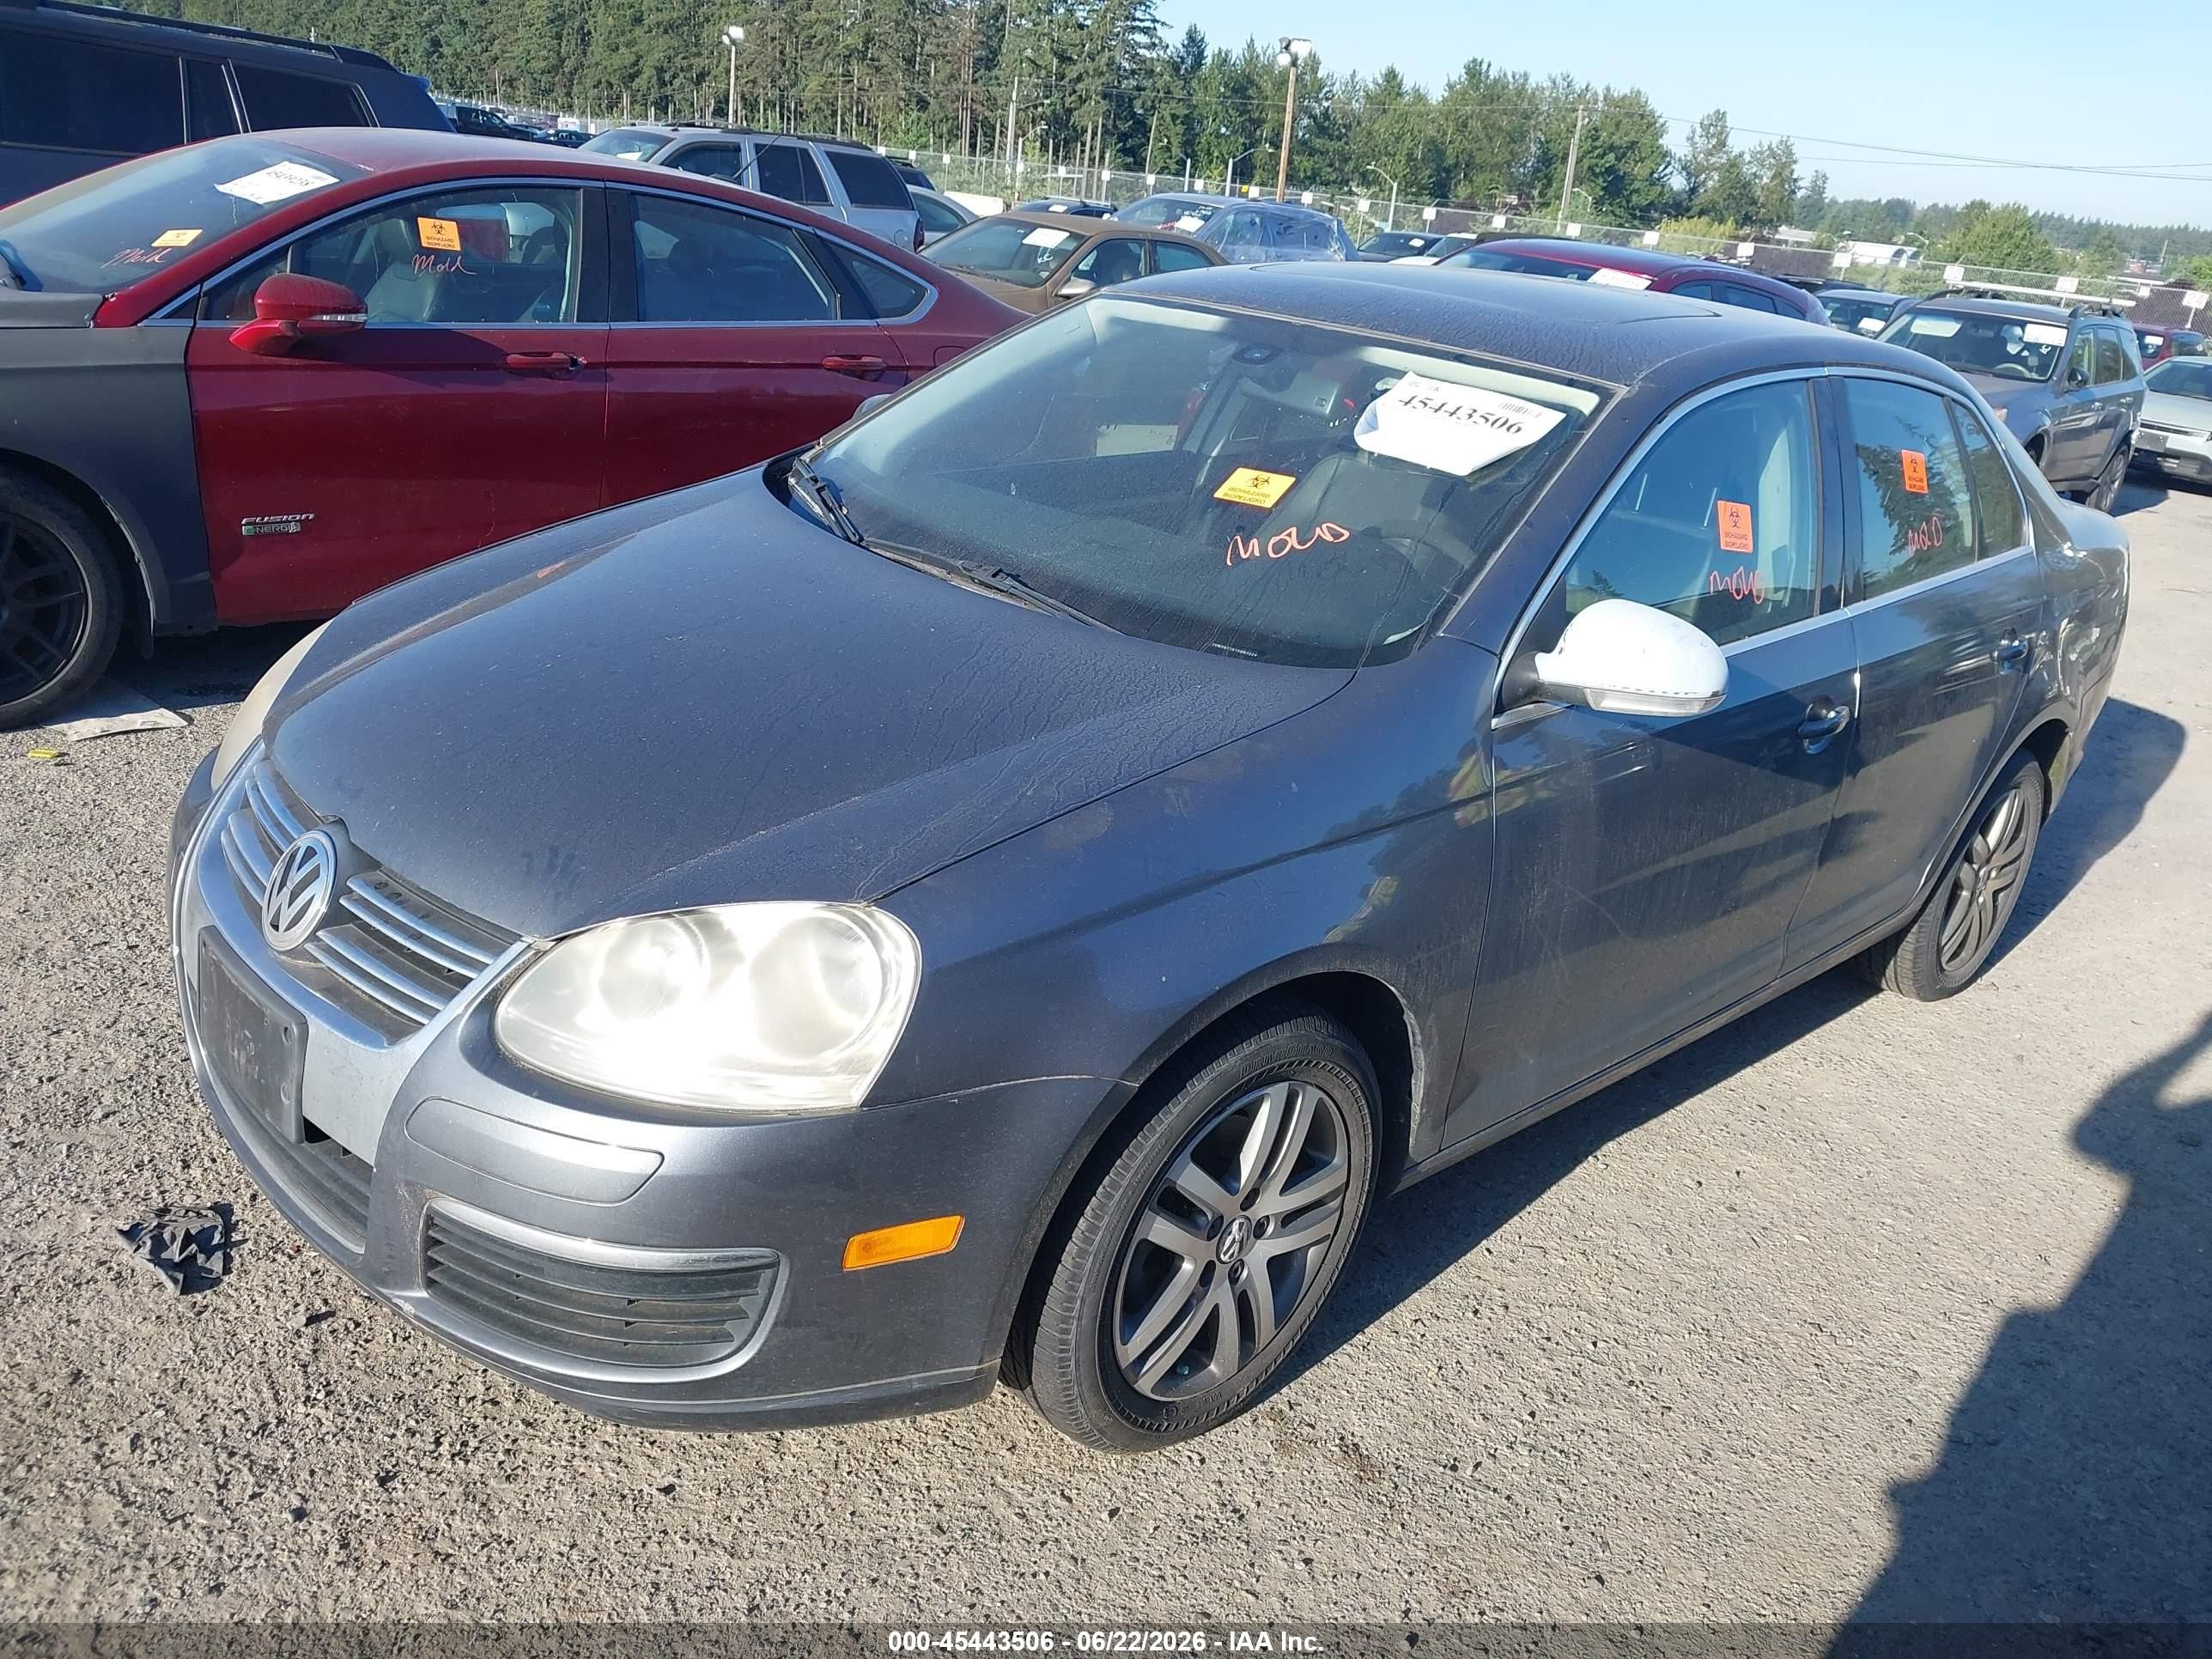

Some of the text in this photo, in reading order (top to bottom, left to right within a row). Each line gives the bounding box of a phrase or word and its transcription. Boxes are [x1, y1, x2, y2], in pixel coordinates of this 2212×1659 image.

[411, 253, 477, 275] Mold
[1398, 394, 1526, 434] 45443506
[1228, 487, 1271, 499] BIOHAZARD
